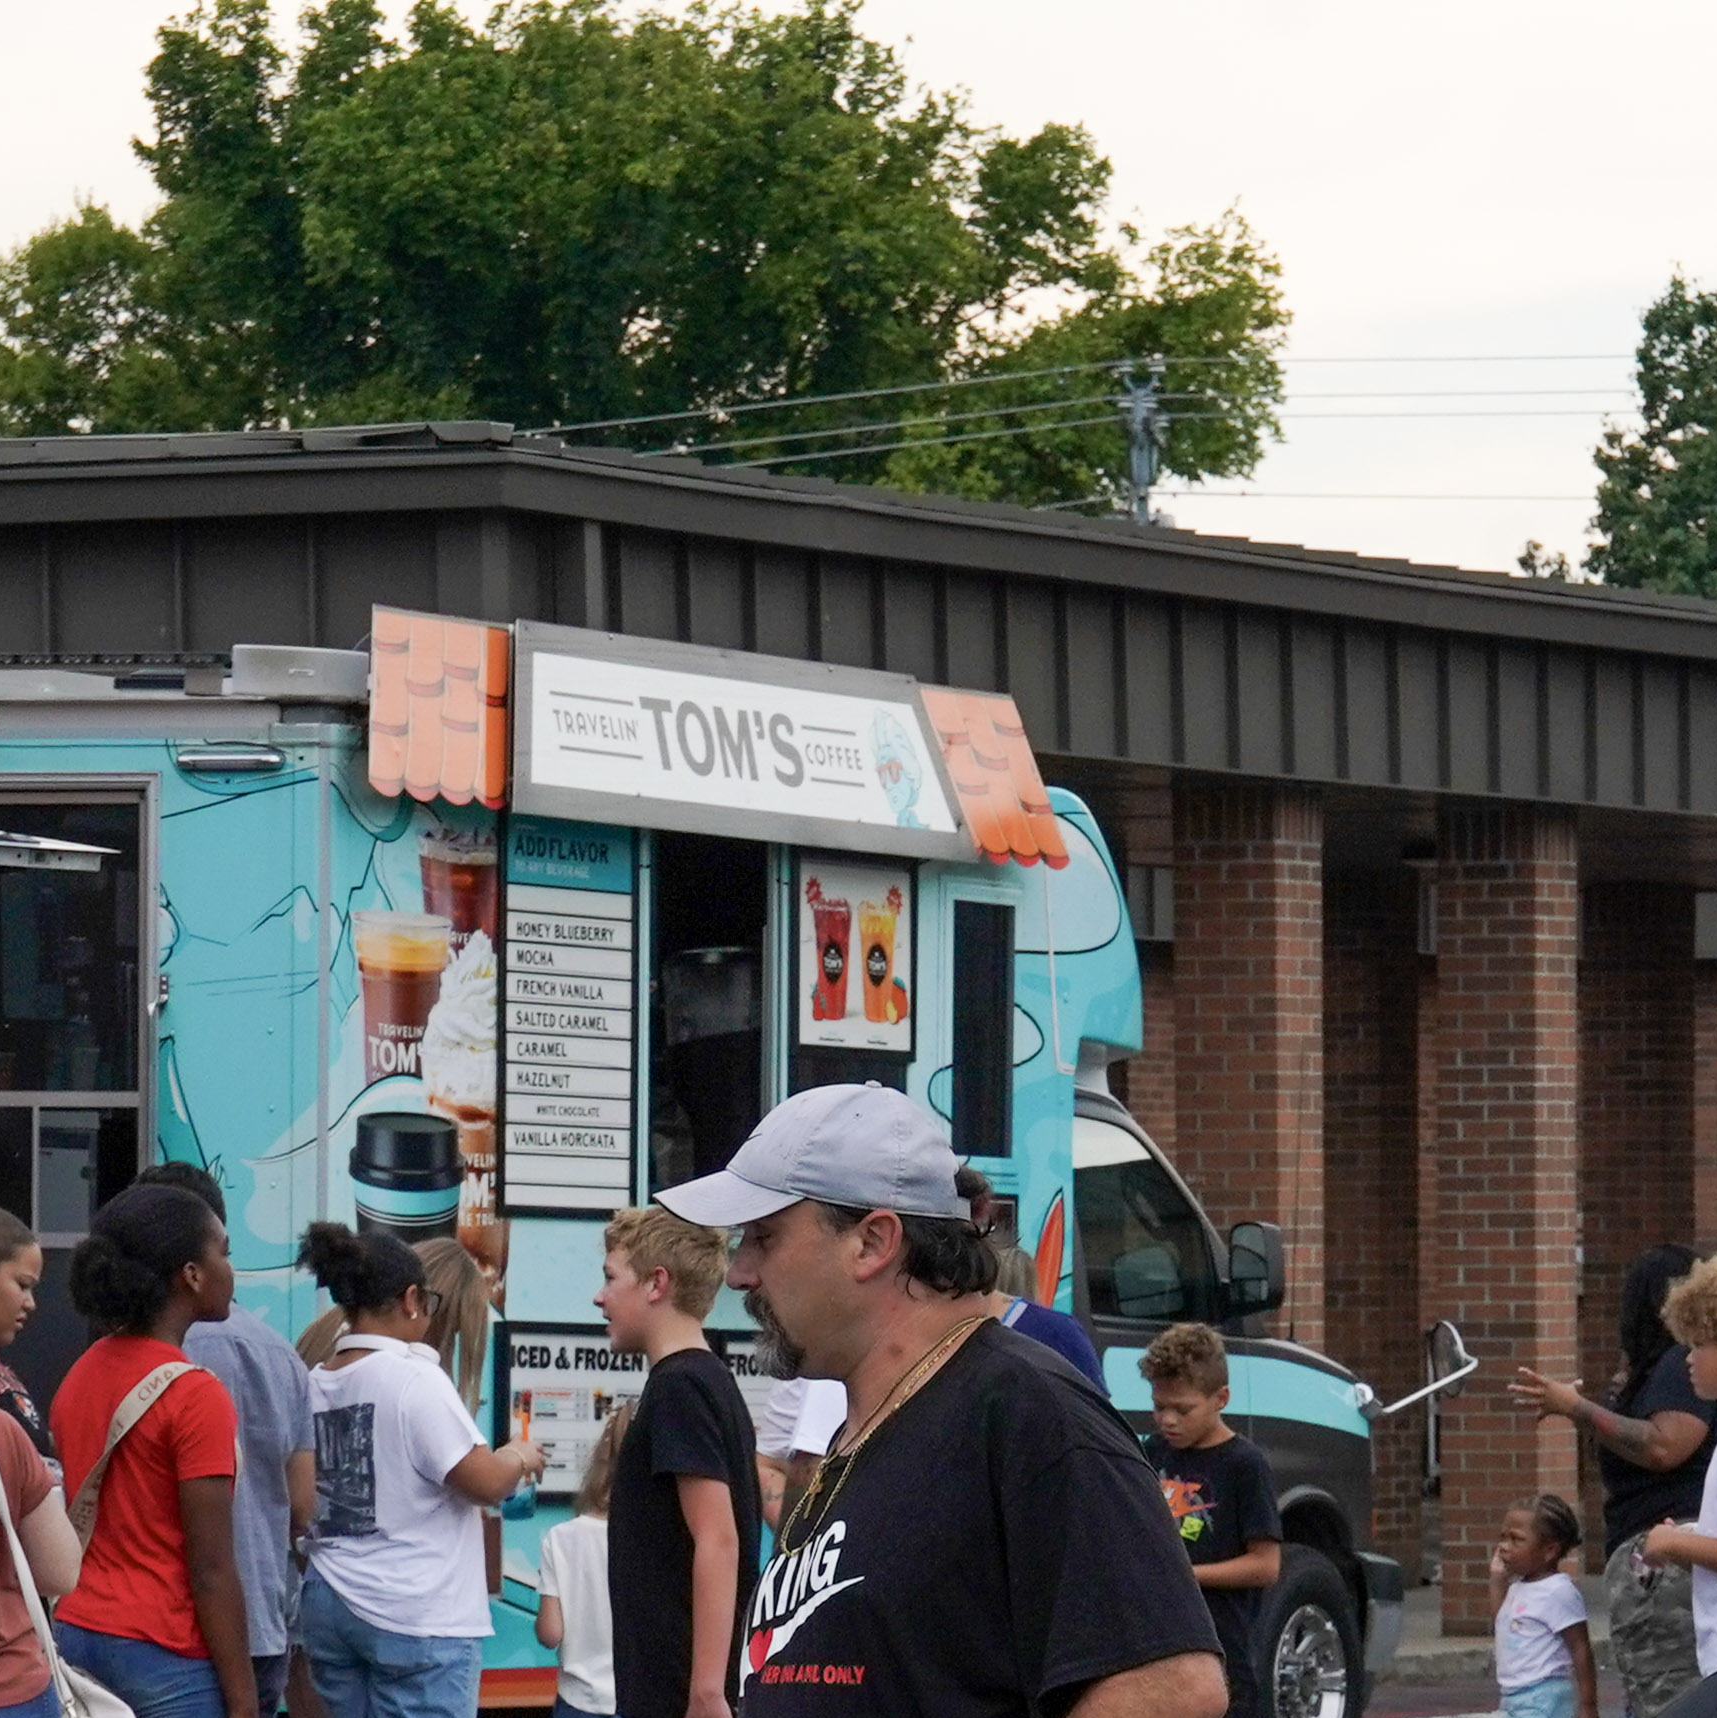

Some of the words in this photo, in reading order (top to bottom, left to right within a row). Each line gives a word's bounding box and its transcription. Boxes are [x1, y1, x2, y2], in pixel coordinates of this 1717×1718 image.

[552, 709, 640, 741] TRAVELIN'
[638, 696, 805, 788] TOM'S
[805, 743, 863, 771] COFFEE
[515, 921, 551, 940] HONEY
[553, 923, 616, 943] BLUEBERRY
[515, 949, 555, 967] MOCHA
[515, 979, 557, 997] FRENCH
[558, 982, 604, 1001] VANILLA
[515, 1010, 557, 1028] SALTED
[558, 1013, 609, 1032] CARAMEL
[516, 1041, 568, 1058] CARAMEL
[516, 1071, 571, 1089] HAZELNUT
[536, 1105, 557, 1117] WHITE
[558, 1106, 600, 1118] CHOCOLATE
[513, 1131, 559, 1147] VANILLA
[560, 1132, 616, 1150] HORCHATA
[512, 1345, 552, 1371] ICED
[554, 1346, 571, 1370] &
[573, 1347, 645, 1373] FROZEN
[751, 1519, 847, 1629] KING
[822, 1664, 866, 1685] ONLY
